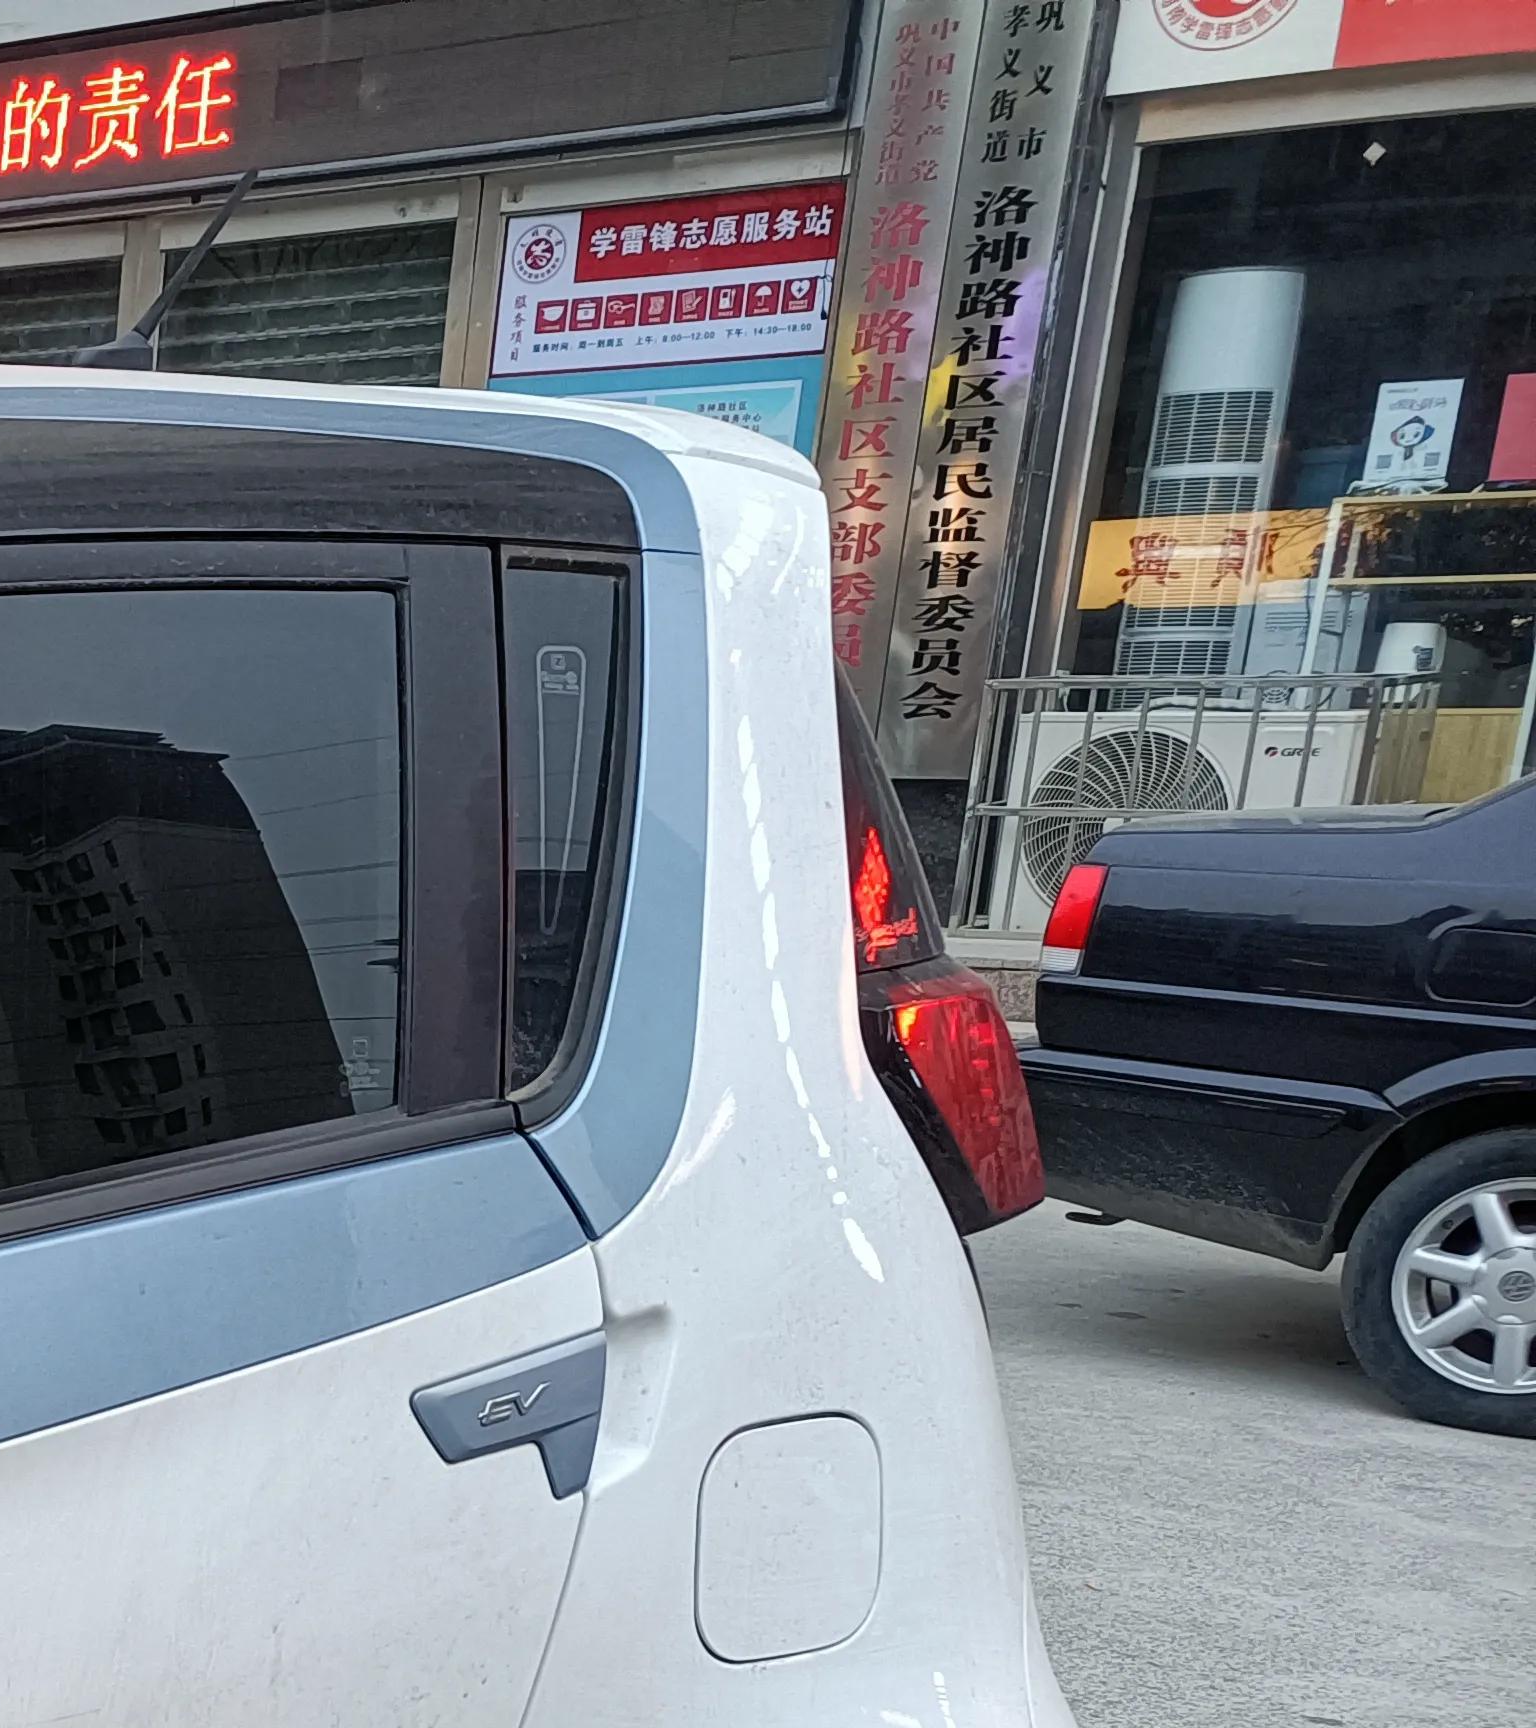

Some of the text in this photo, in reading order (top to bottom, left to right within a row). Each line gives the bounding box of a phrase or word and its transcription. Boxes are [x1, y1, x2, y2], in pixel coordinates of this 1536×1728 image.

[910, 17, 960, 183] 中国共产党
[981, 4, 1031, 163] 孝义街道
[1017, 0, 1065, 160] 巩义市
[589, 203, 834, 260] 学雷锋志愿服务站
[898, 185, 1039, 720] 洛神路社区居民监督委员会
[1281, 747, 1320, 757] GRE
[478, 1380, 552, 1428] EV
